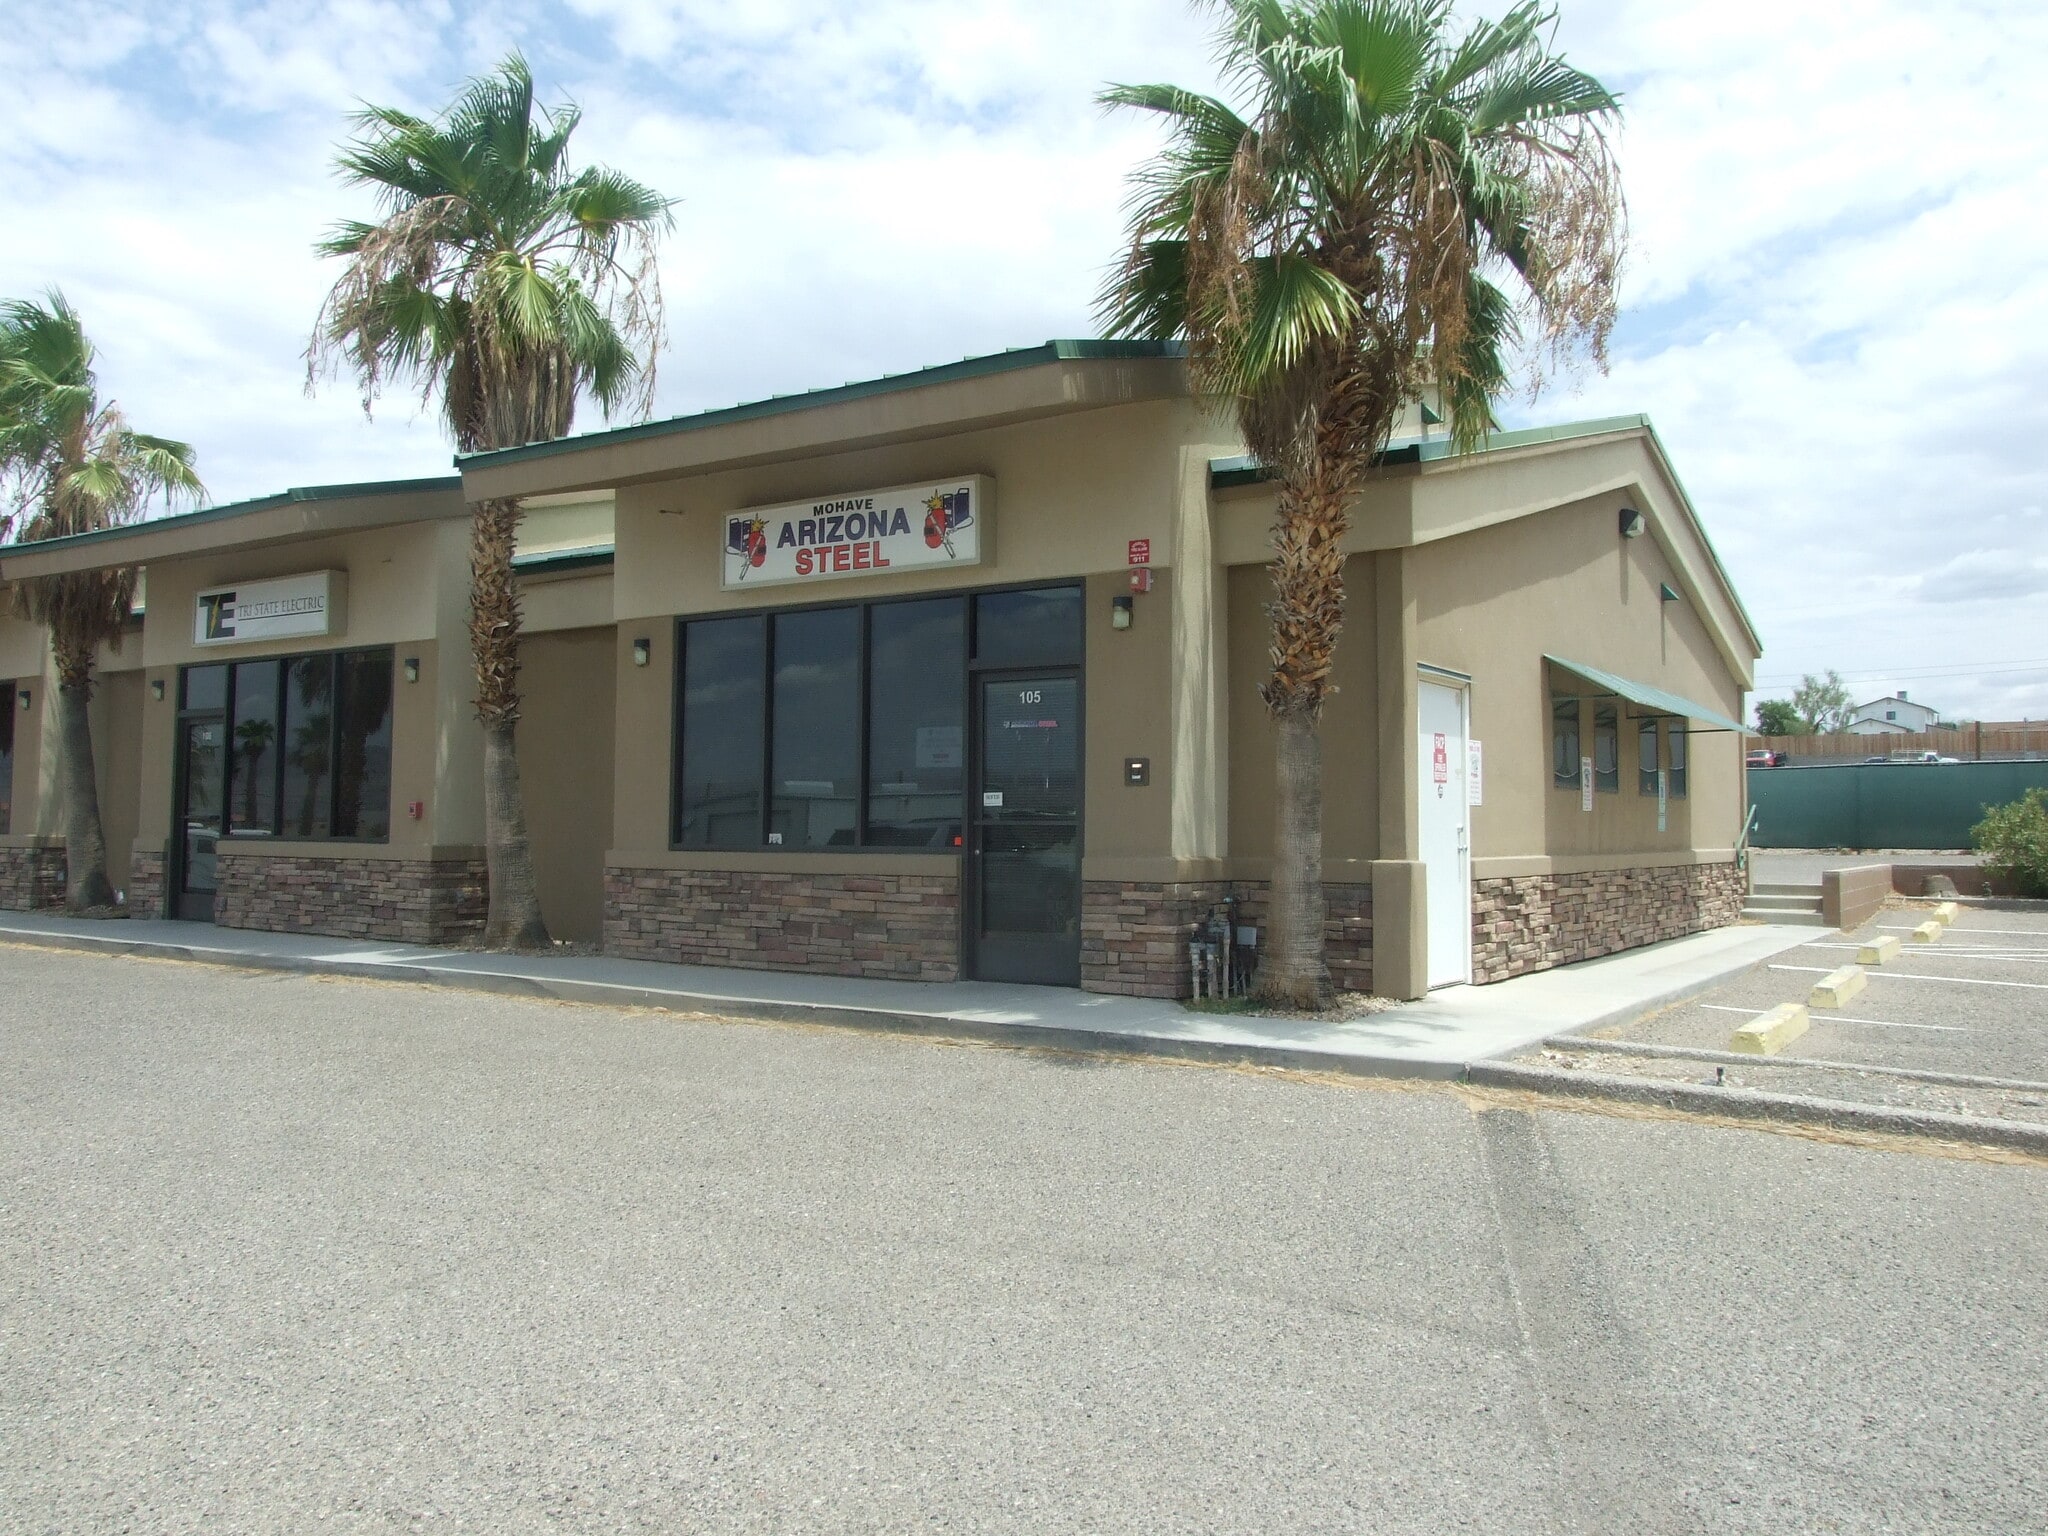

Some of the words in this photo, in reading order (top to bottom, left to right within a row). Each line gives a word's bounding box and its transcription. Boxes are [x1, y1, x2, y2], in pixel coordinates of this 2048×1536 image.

[813, 499, 873, 516] MOHAVE
[777, 508, 911, 548] ARIZONA
[795, 541, 890, 575] STEEL
[238, 605, 252, 617] TRI
[254, 601, 279, 616] STATE
[281, 595, 325, 614] ELECTRIC
[1019, 690, 1041, 704] 105
